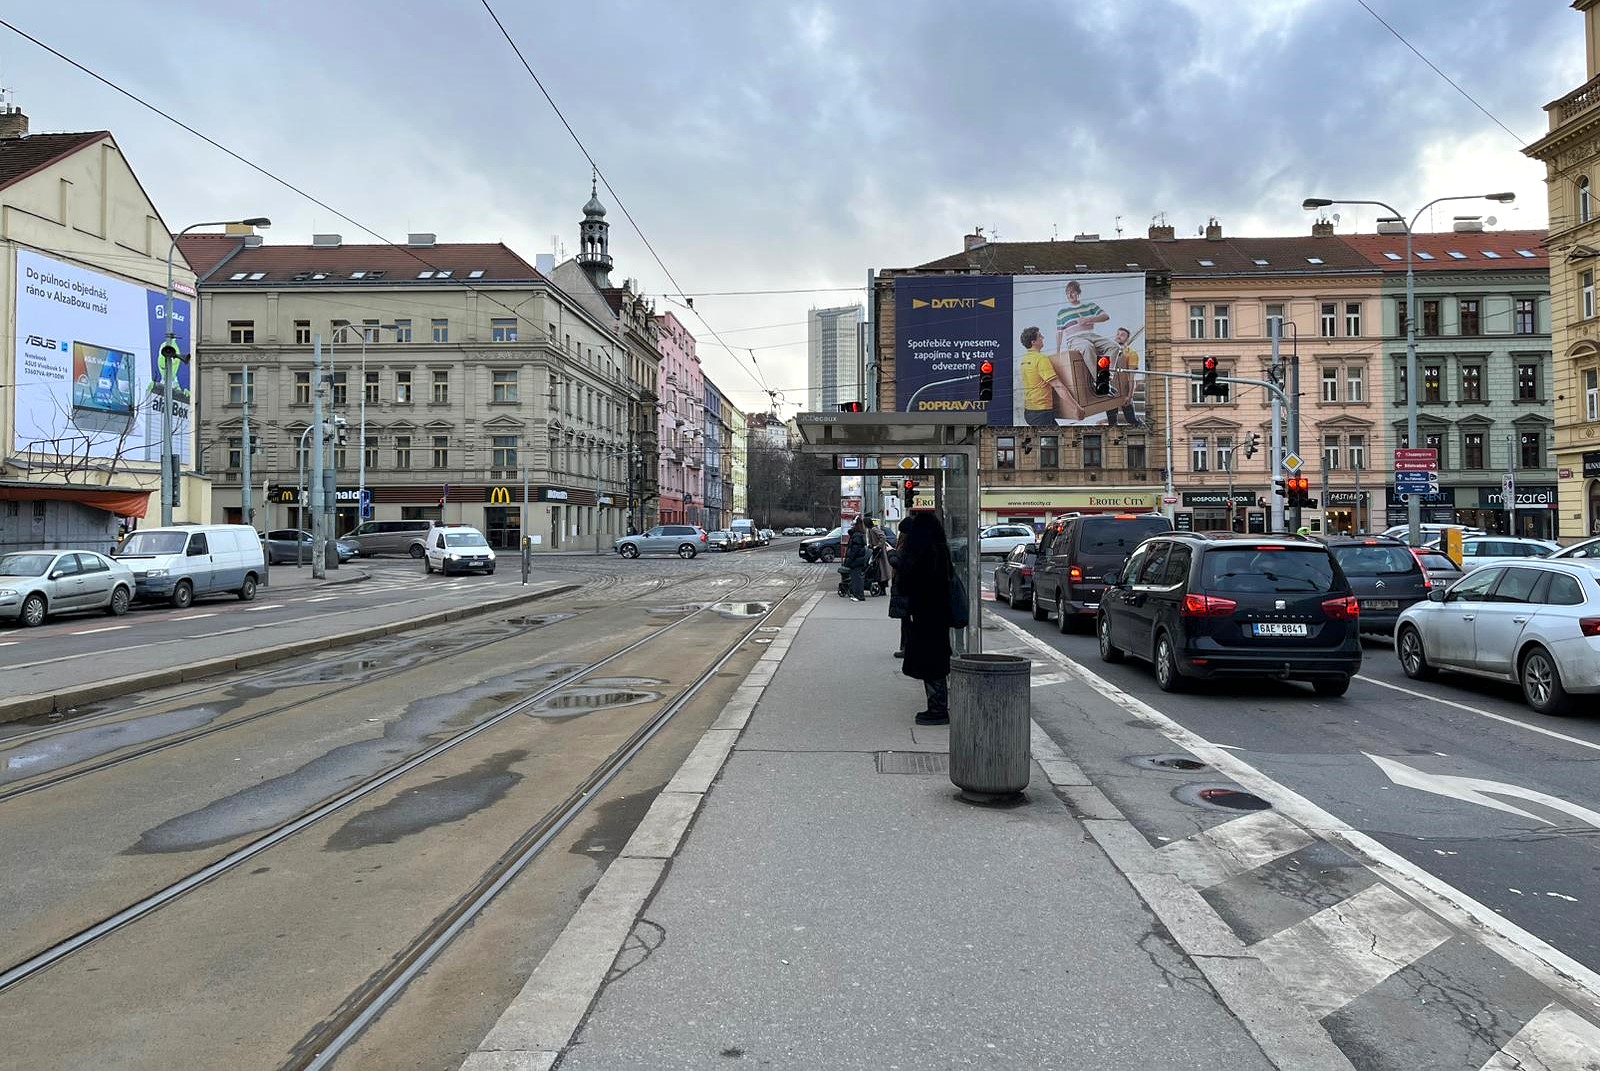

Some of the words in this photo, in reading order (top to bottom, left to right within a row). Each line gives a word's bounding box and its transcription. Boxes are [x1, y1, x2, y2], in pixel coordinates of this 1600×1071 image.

[26, 267, 39, 280] Do
[71, 281, 109, 301] objednáš,
[26, 284, 45, 298] ráno
[47, 291, 52, 299] v
[54, 291, 91, 310] AlzaBoxu
[92, 303, 108, 315] máš
[931, 298, 977, 308] DATART
[25, 335, 56, 350] ASUS
[907, 339, 952, 350] Spotřebiče
[953, 340, 1000, 348] vyneseme,
[914, 350, 952, 360] zapojíme
[961, 351, 971, 360] ty
[972, 350, 994, 359] staré
[932, 362, 976, 371] odvezeme
[918, 400, 990, 410] DOPRAVART
[916, 498, 934, 506] ERO
[1488, 491, 1553, 504] mzarell
[1260, 624, 1276, 633] 6AE
[1282, 625, 1303, 633] 8841
